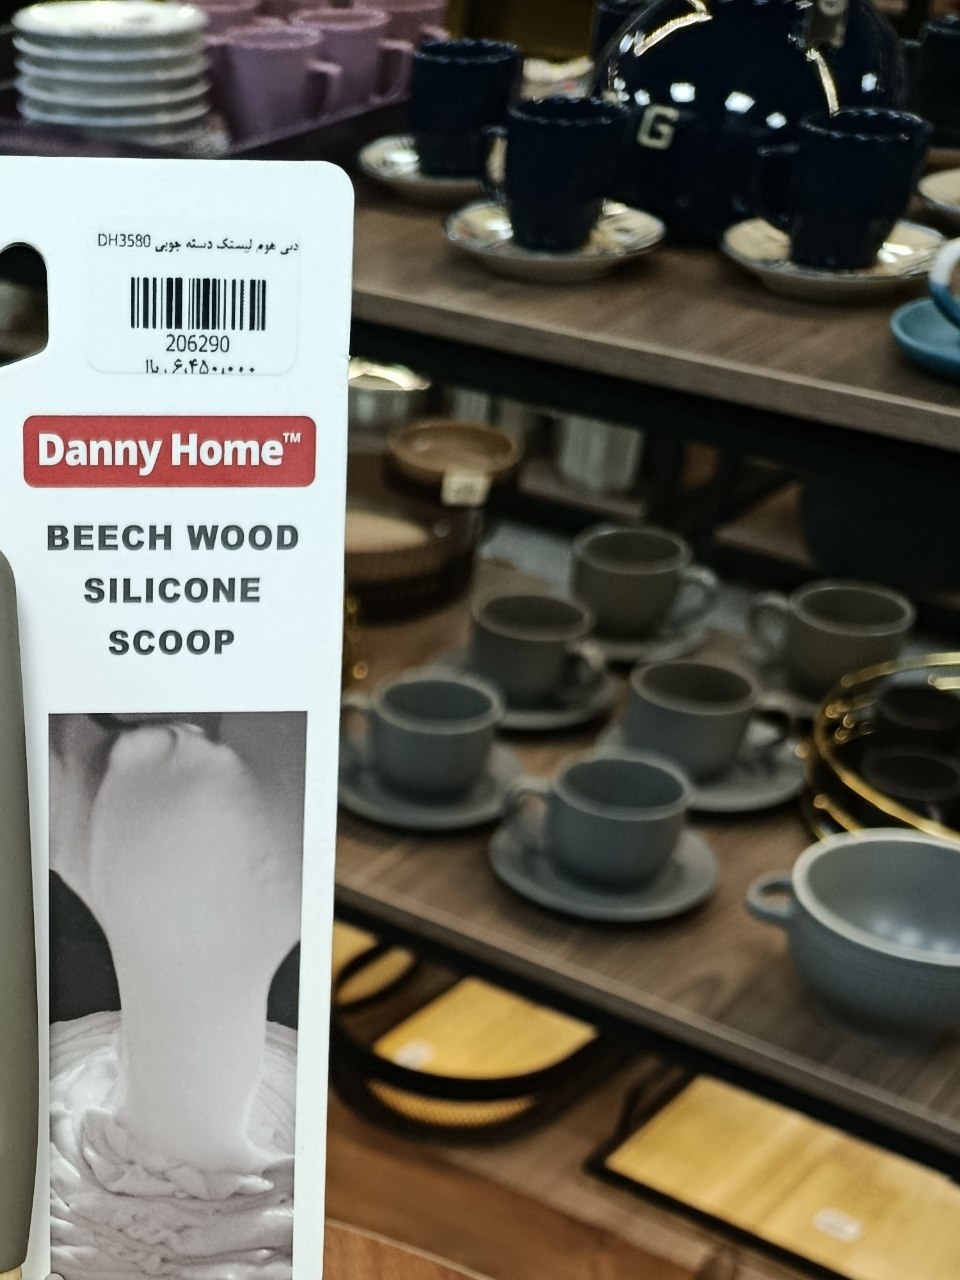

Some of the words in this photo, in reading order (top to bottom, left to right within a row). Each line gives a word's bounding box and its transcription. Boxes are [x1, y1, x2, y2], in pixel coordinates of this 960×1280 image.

[165, 333, 230, 353] 206290
[38, 433, 163, 476] Danny
[47, 524, 172, 551] BEECH
[187, 524, 299, 551] WOOD
[83, 577, 261, 604] SILICONE
[108, 629, 235, 656] SCOOP
